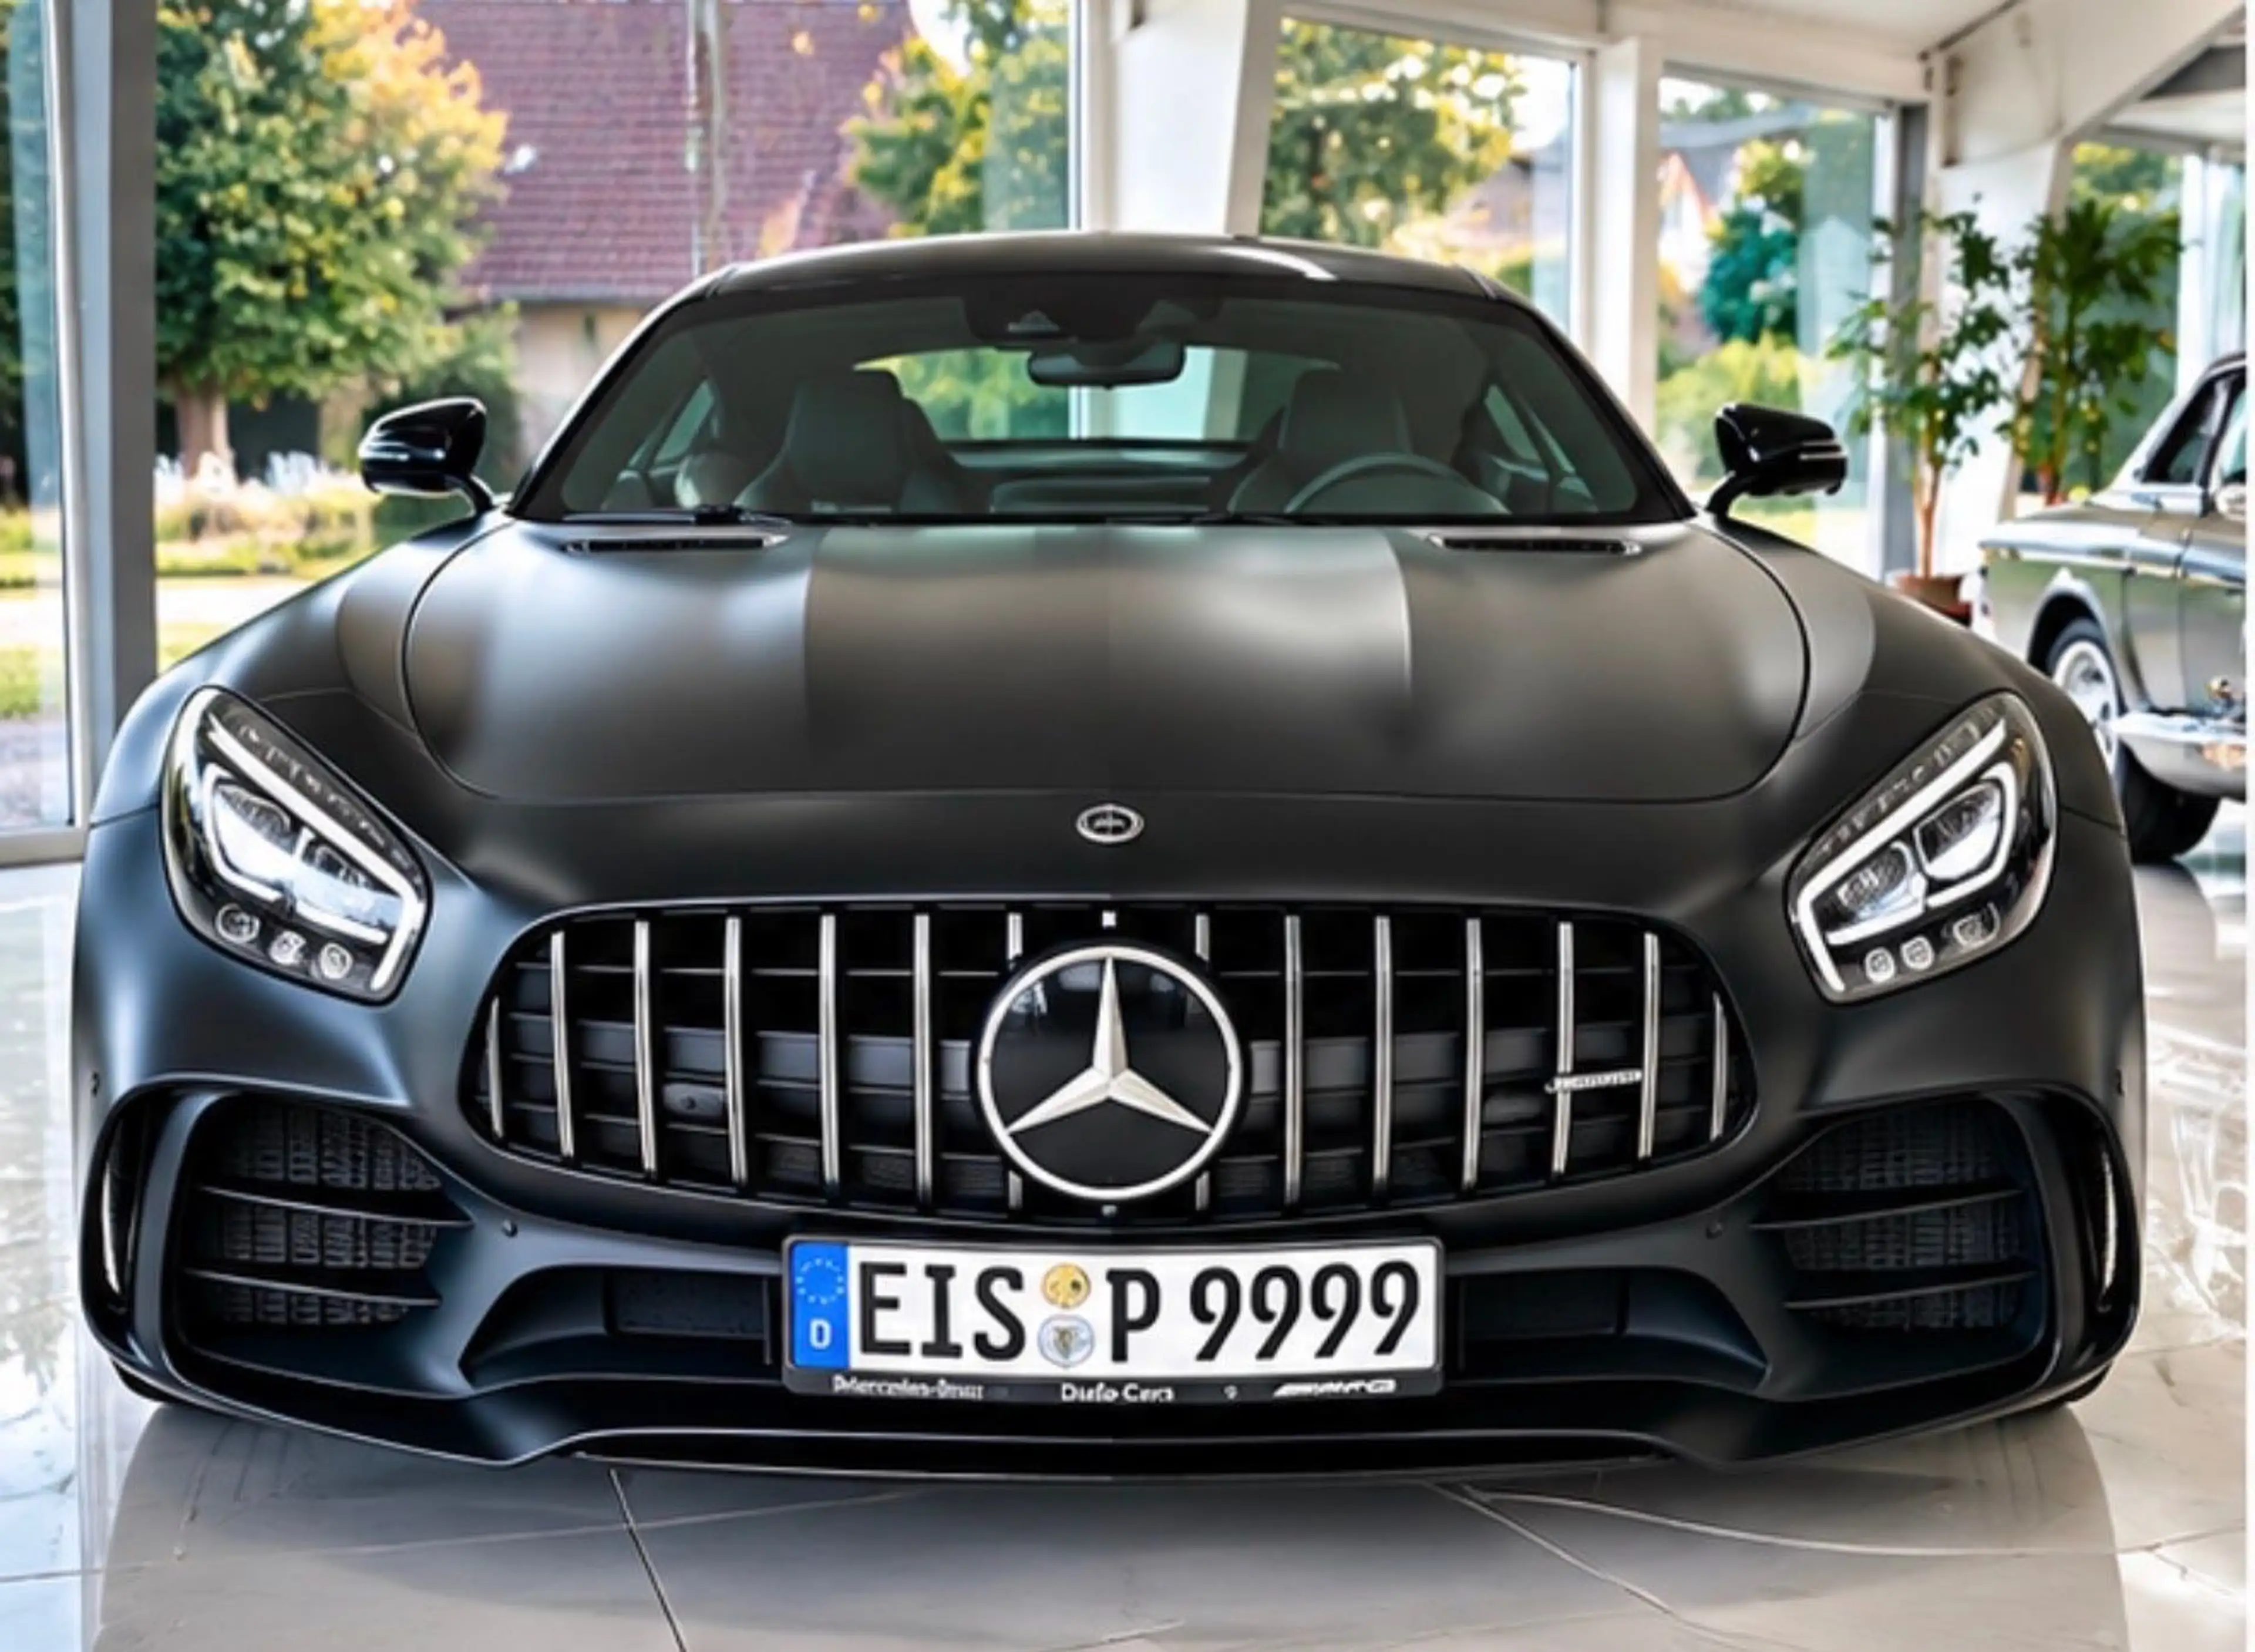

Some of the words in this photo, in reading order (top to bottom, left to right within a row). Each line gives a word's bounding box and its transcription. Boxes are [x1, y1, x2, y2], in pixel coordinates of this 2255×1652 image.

[809, 1319, 832, 1349] D
[859, 1261, 1026, 1361] EIS
[1105, 1268, 1161, 1363] P
[1189, 1260, 1419, 1362] 9999
